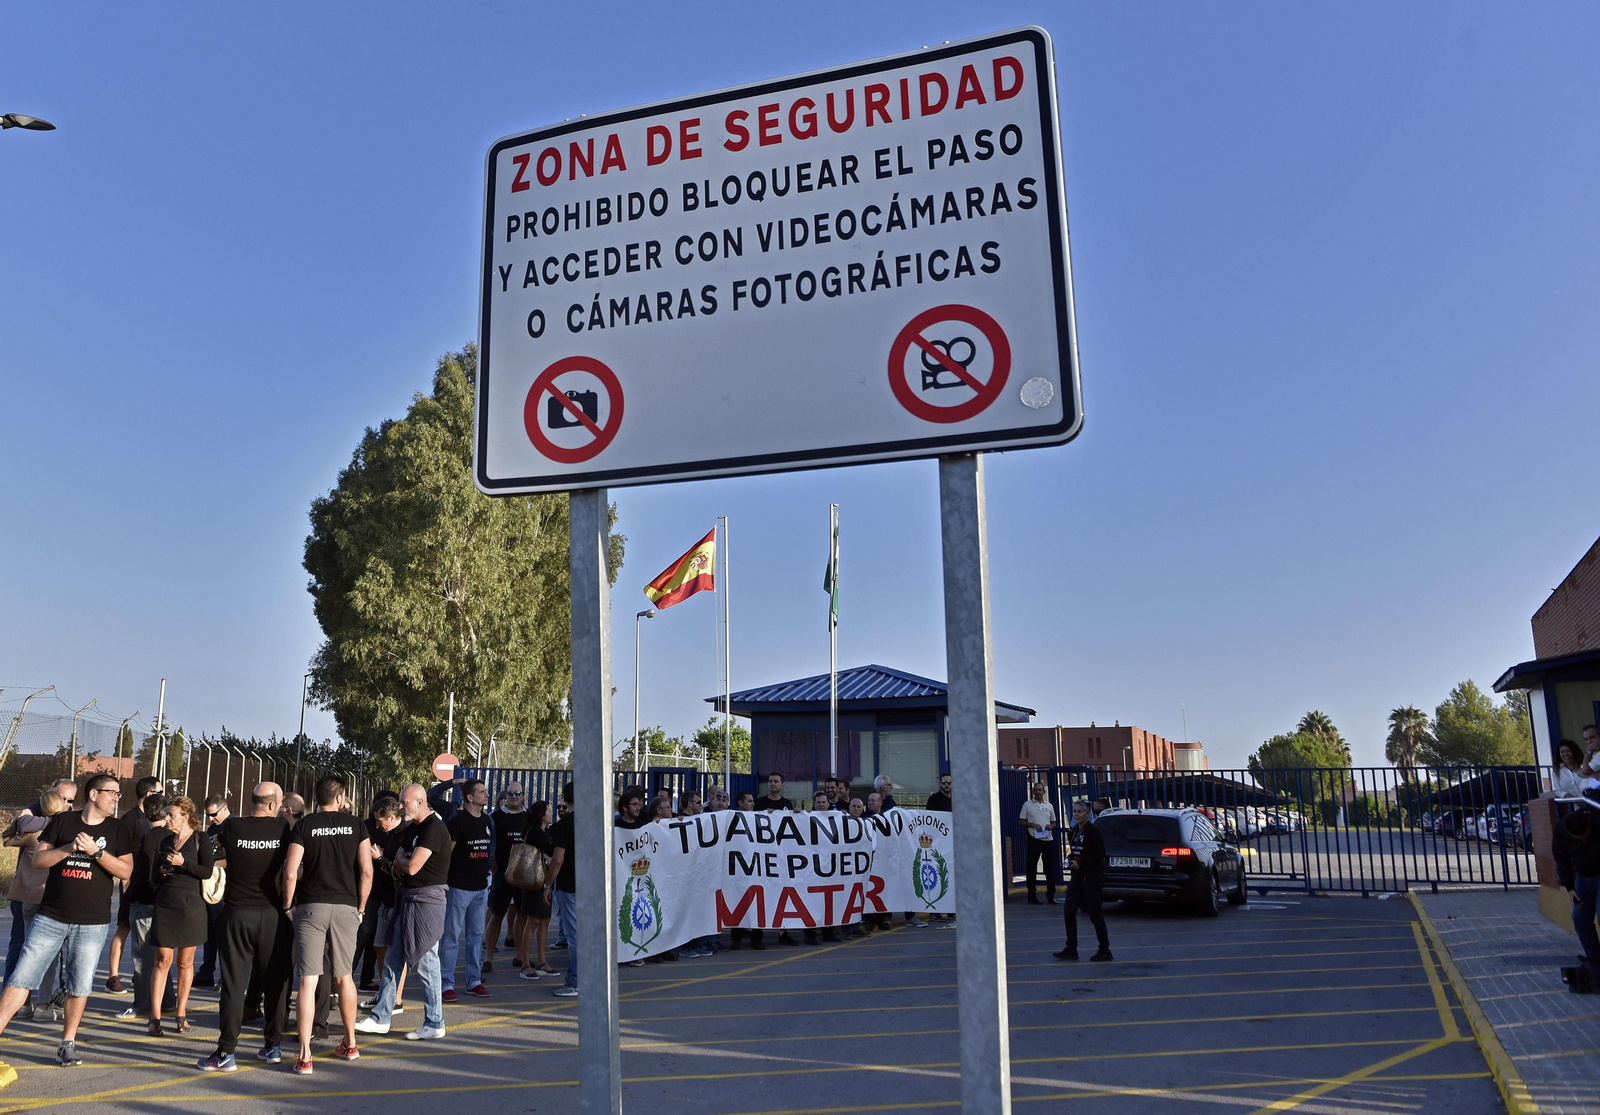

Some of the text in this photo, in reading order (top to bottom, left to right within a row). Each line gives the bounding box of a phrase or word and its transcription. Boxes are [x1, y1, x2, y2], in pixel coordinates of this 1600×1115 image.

[511, 56, 1024, 193] ZONA DE SEGURIDAD
[506, 123, 1023, 243] PROHIBIDO BLOQUEAR EL PASO
[498, 176, 1039, 293] Y ACCEDER CON VIDEOCÁMARAS
[527, 240, 1002, 339] O CÁMARAS FOTOGRÁFICAS
[237, 839, 281, 849] PRISIONES
[312, 827, 353, 837] PRISIONES
[669, 814, 720, 854] TU
[62, 868, 93, 880] MATAR
[728, 850, 876, 879] ME PUED
[714, 874, 889, 933] MATAR
